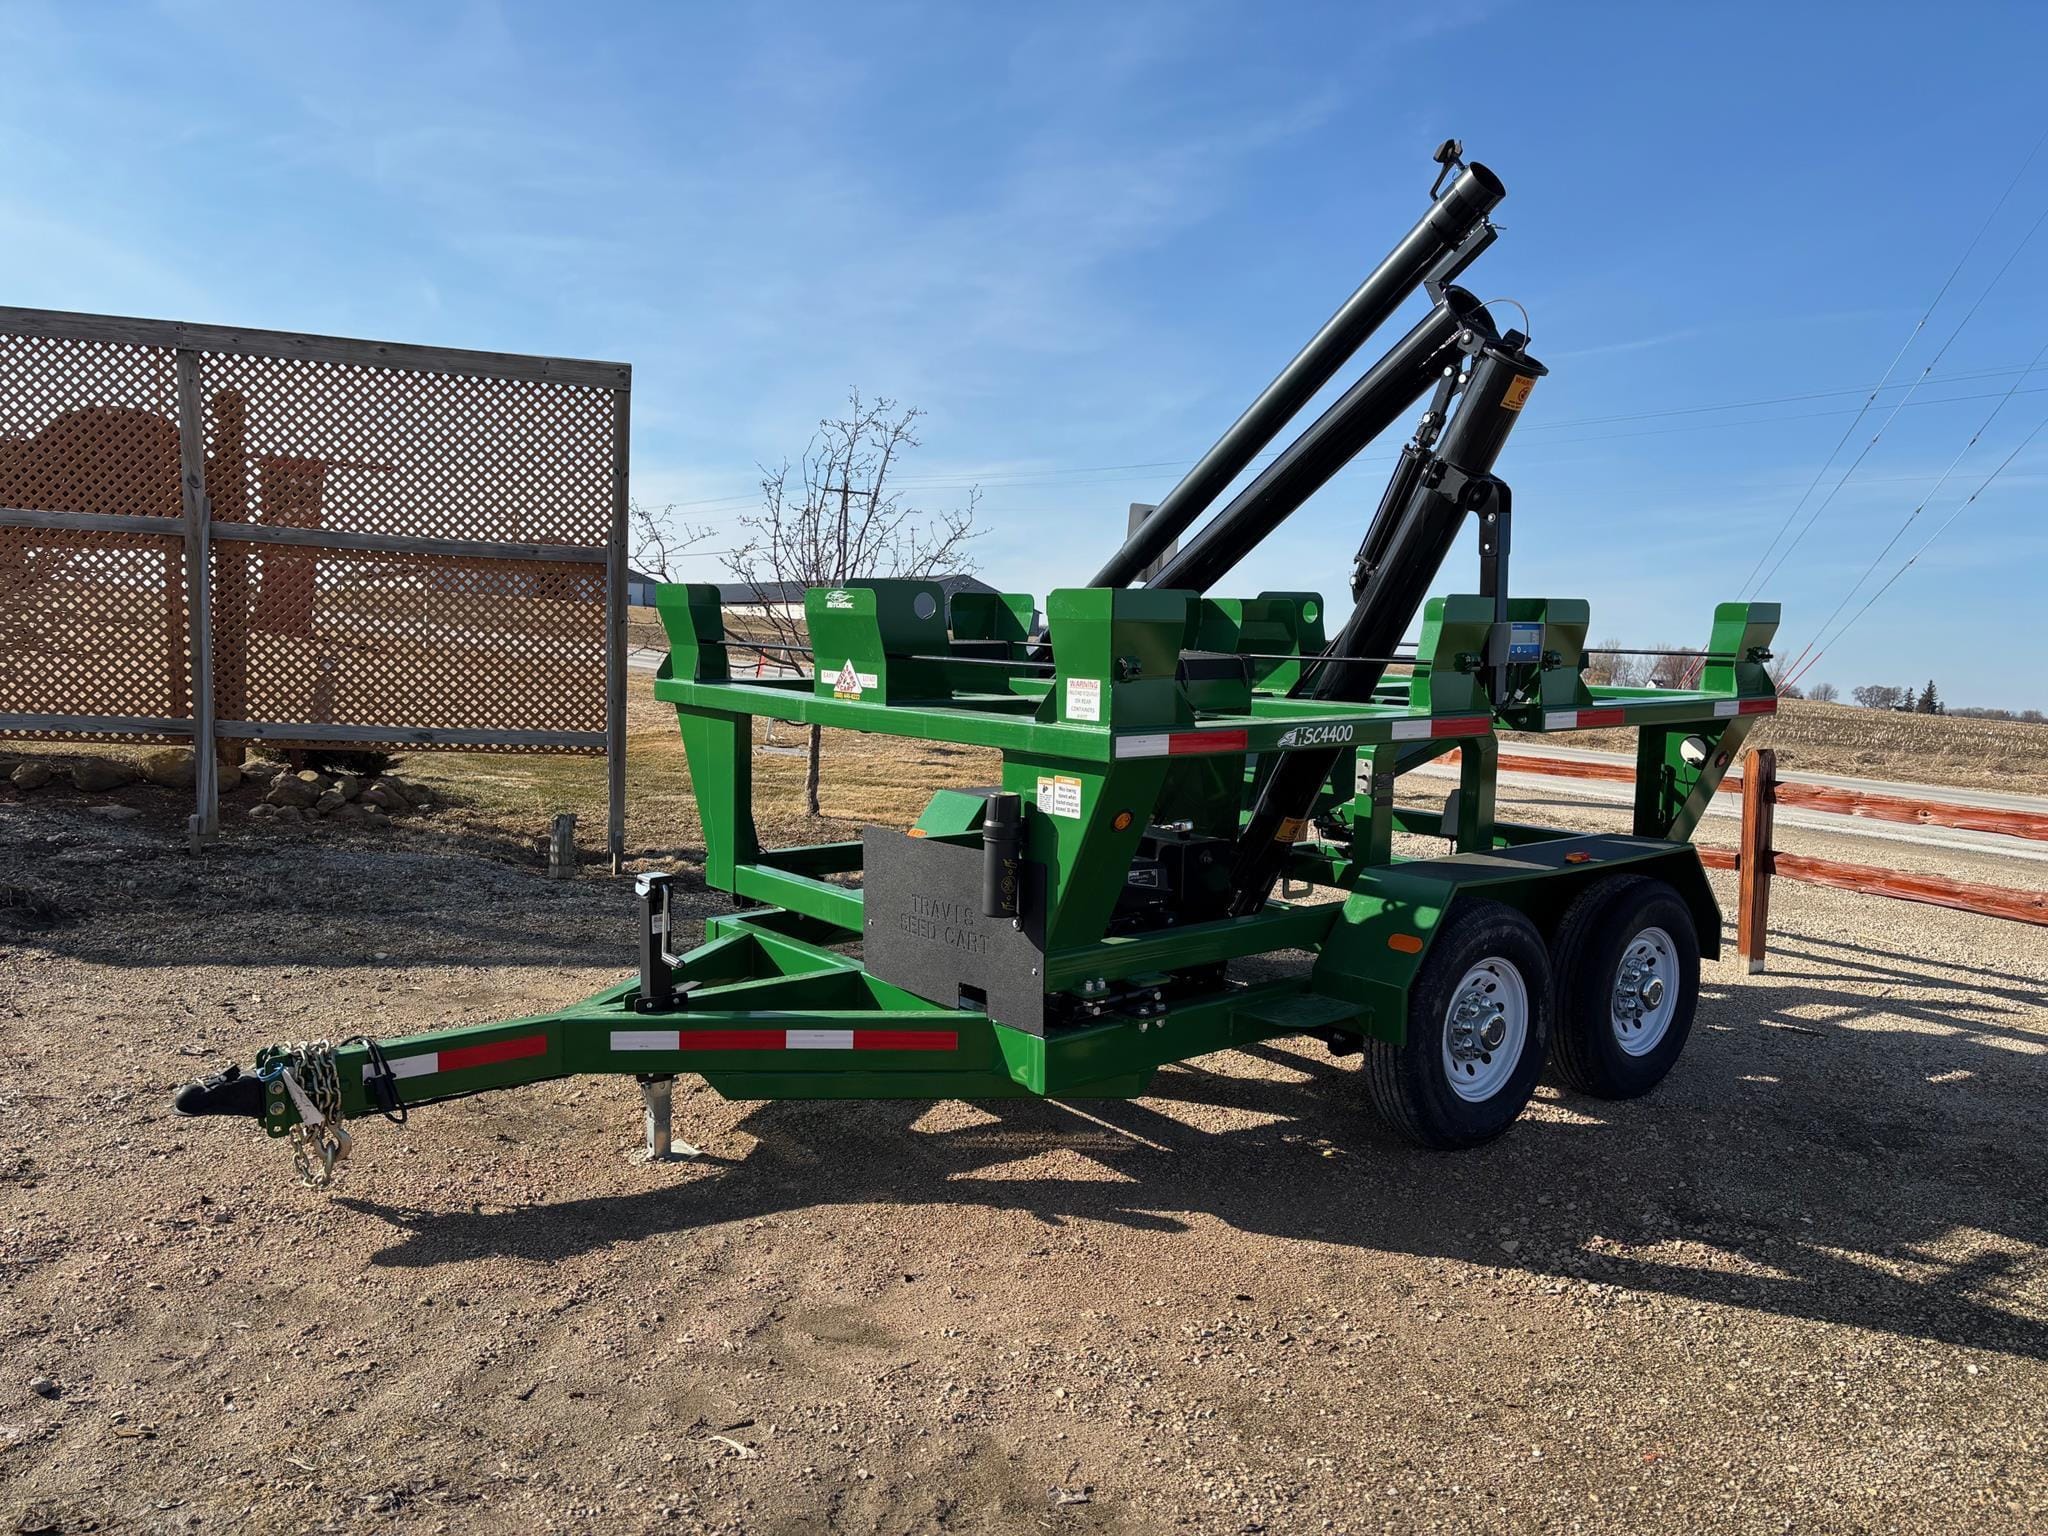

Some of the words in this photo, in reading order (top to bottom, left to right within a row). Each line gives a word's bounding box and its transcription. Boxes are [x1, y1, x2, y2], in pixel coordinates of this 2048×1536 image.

[911, 893, 974, 926] TRAVIS
[900, 912, 936, 940] SEED
[945, 926, 990, 955] CART
